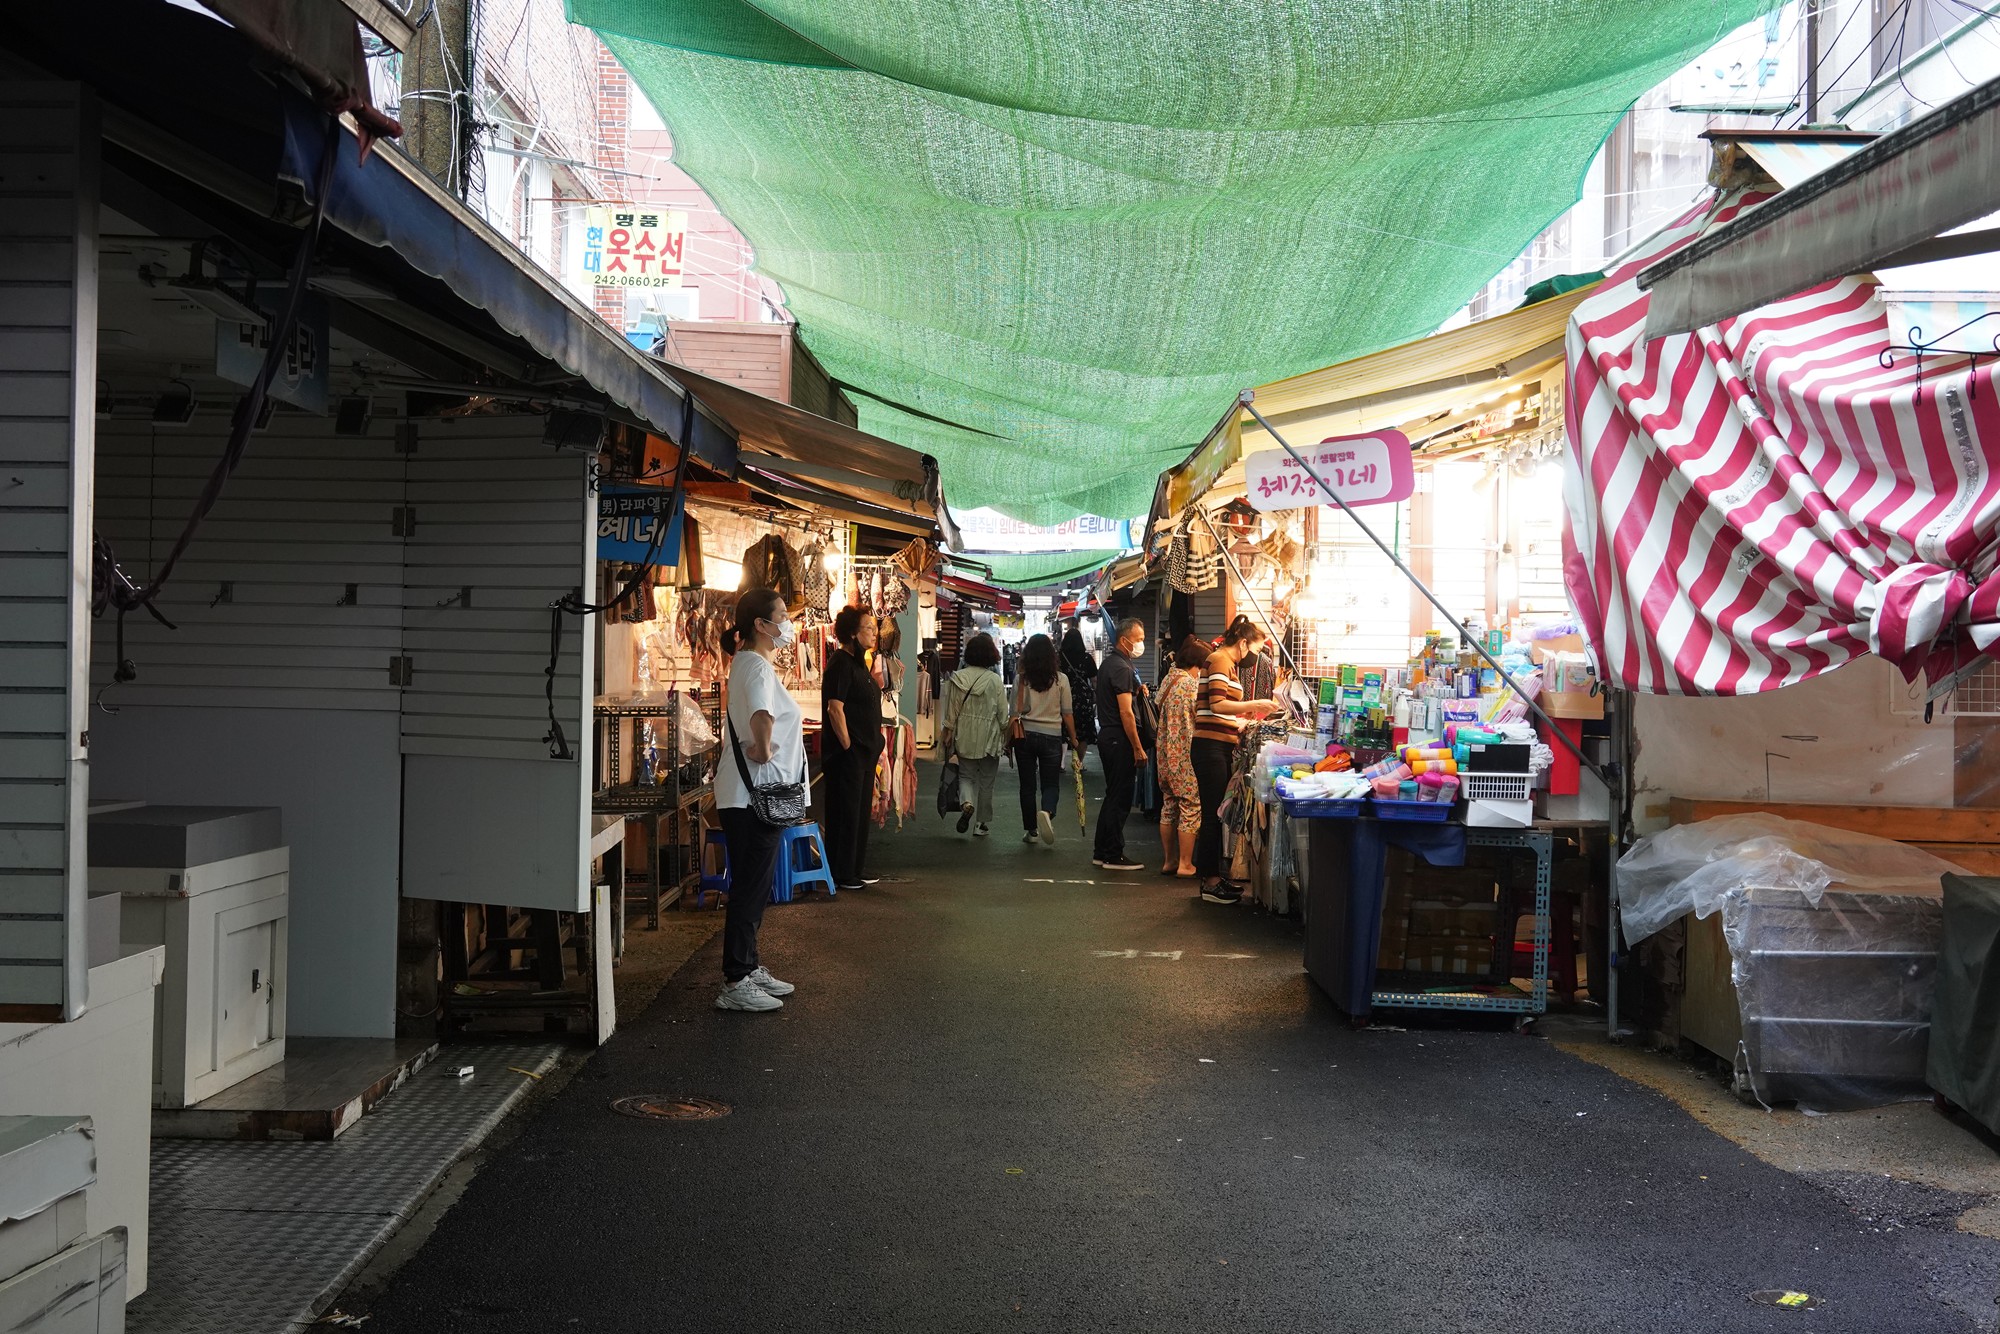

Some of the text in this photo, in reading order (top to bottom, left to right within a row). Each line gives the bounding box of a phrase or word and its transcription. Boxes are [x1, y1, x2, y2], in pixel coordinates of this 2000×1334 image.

[616, 213, 659, 228] 명품
[583, 226, 603, 273] 현대
[606, 228, 684, 275] 옷수선
[594, 274, 670, 288] 242-0660 2F
[1319, 450, 1356, 464] 생활잡화
[1057, 518, 1077, 535] 감사
[1079, 516, 1118, 534] 드립니다
